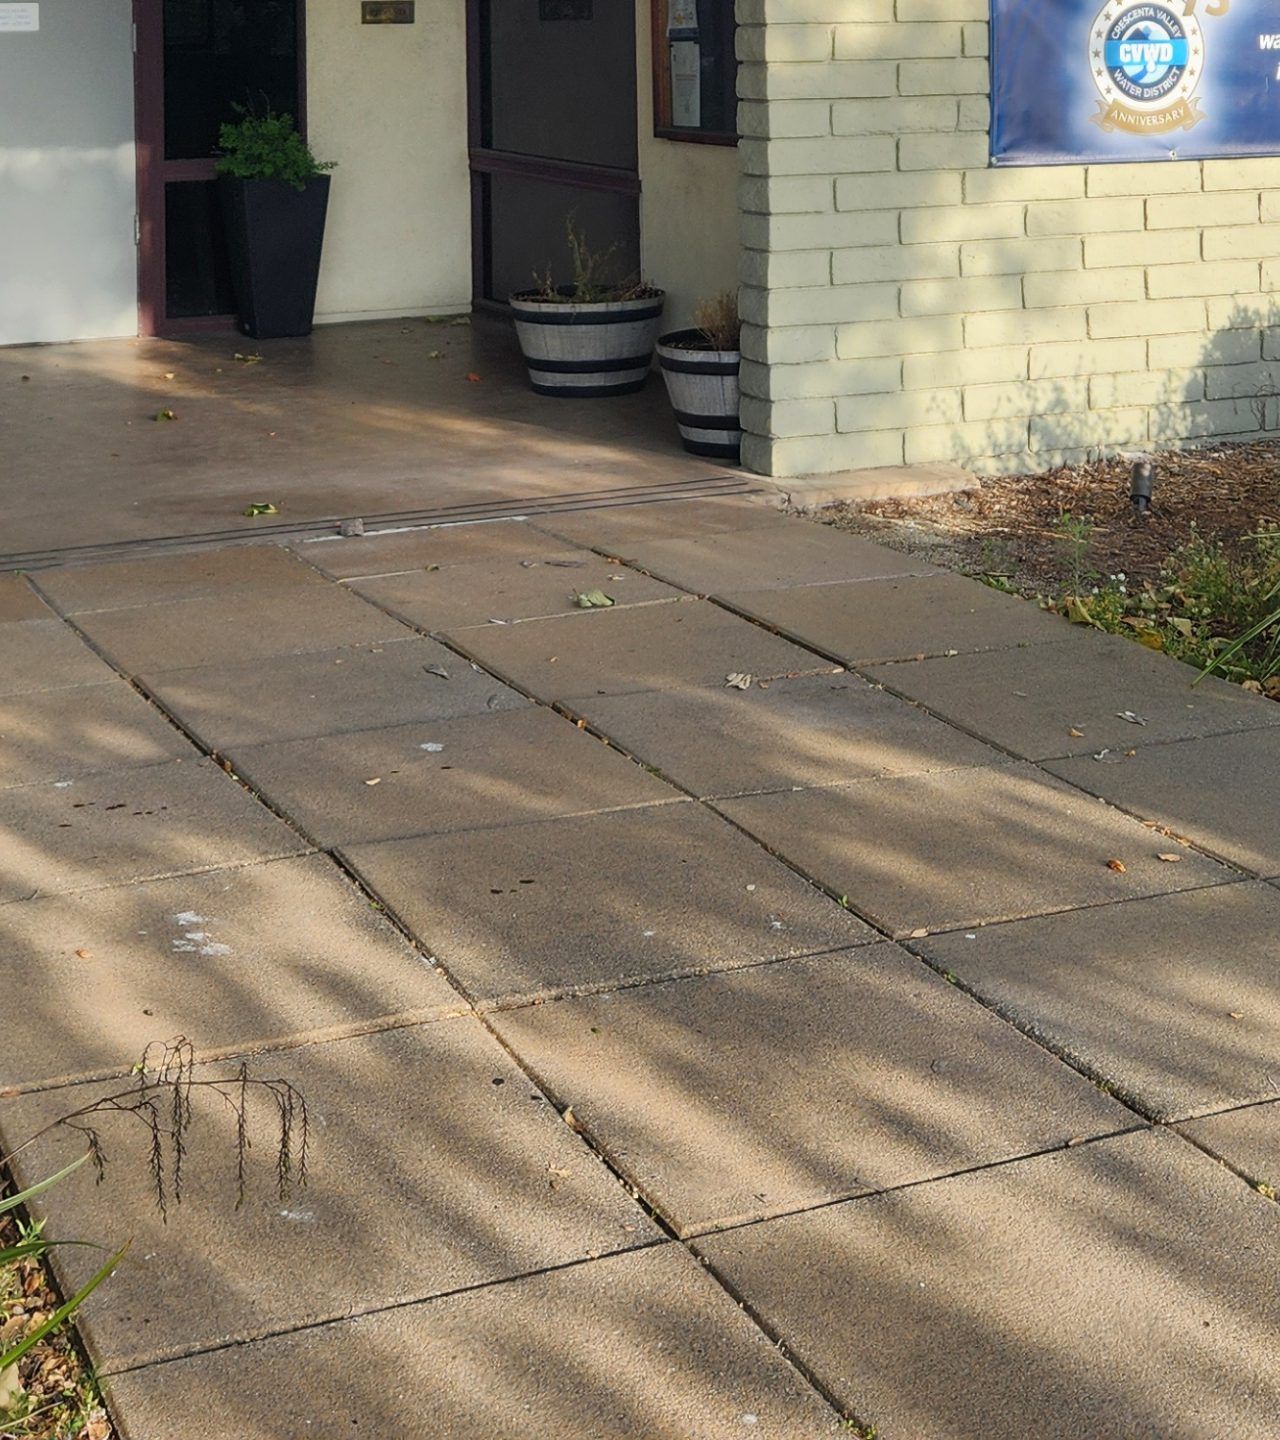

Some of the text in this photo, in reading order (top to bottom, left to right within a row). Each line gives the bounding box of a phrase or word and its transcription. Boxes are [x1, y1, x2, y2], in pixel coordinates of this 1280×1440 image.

[1111, 7, 1183, 39] CRESCENTA VALLEY
[1119, 43, 1173, 63] CVWD
[1113, 66, 1182, 98] WATER DISTRICT
[1111, 107, 1186, 127] ANNIVERSARY
